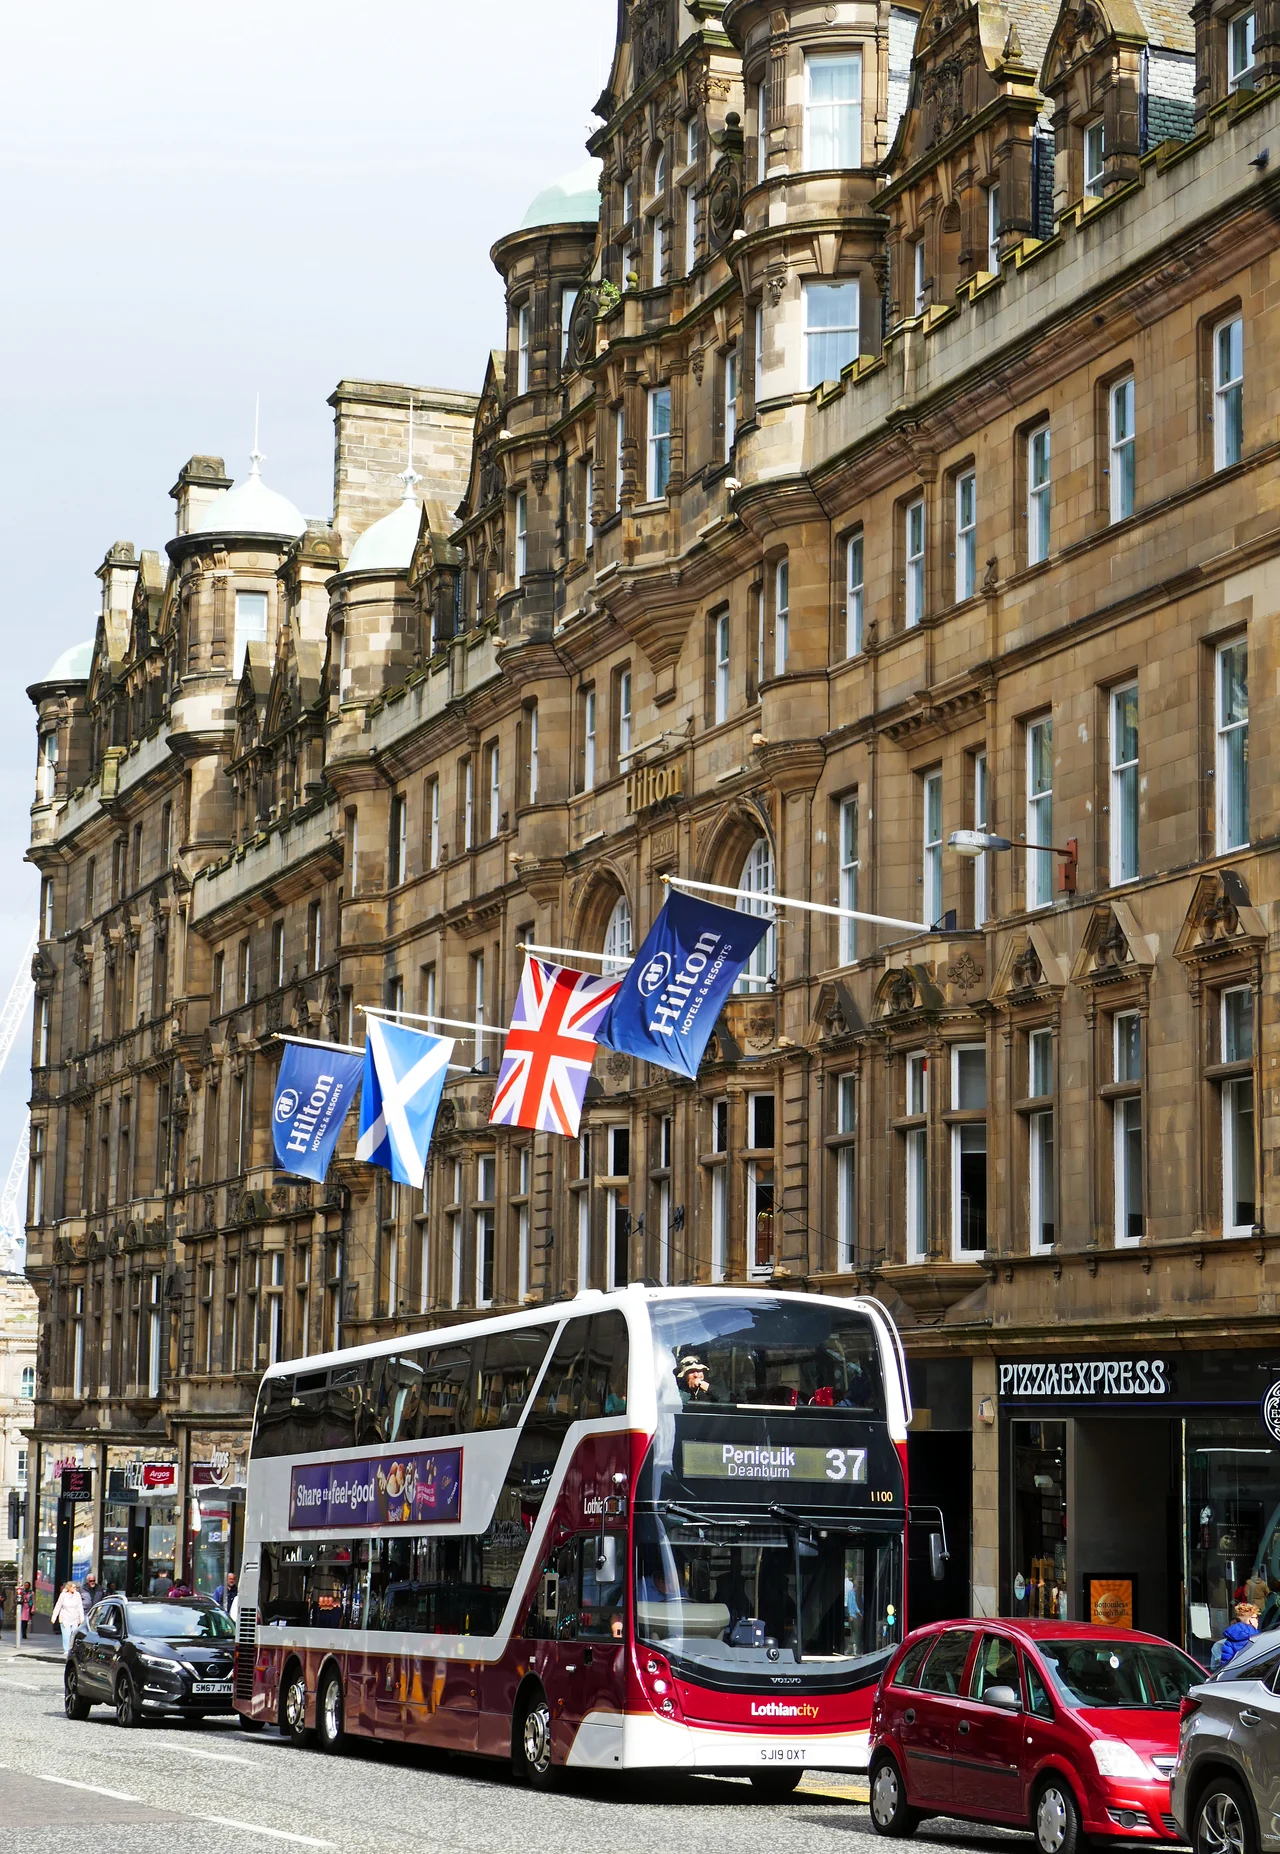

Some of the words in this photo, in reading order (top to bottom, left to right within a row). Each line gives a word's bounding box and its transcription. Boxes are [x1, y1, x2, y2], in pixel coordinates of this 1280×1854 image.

[624, 765, 682, 817] Hilton
[649, 932, 721, 1037] Hilton
[680, 996, 703, 1035] HOTELS
[704, 944, 732, 986] RESORTS
[286, 1075, 334, 1153] Hilton
[312, 1123, 327, 1152] HOTELS
[325, 1083, 344, 1116] RESORTS
[211, 1445, 229, 1474] Argos
[722, 1445, 796, 1466] Penicuik
[825, 1449, 865, 1480] 37
[149, 1470, 170, 1479] Argos
[728, 1464, 790, 1478] Deanburn
[62, 1491, 90, 1499] PREZZO
[297, 1485, 322, 1506] Share
[331, 1478, 375, 1509] feel-good
[870, 1491, 893, 1502] 1100
[195, 1684, 215, 1692] SM67
[217, 1684, 232, 1692] JYN
[761, 1750, 784, 1760] SJ19
[786, 1750, 806, 1760] OXT
